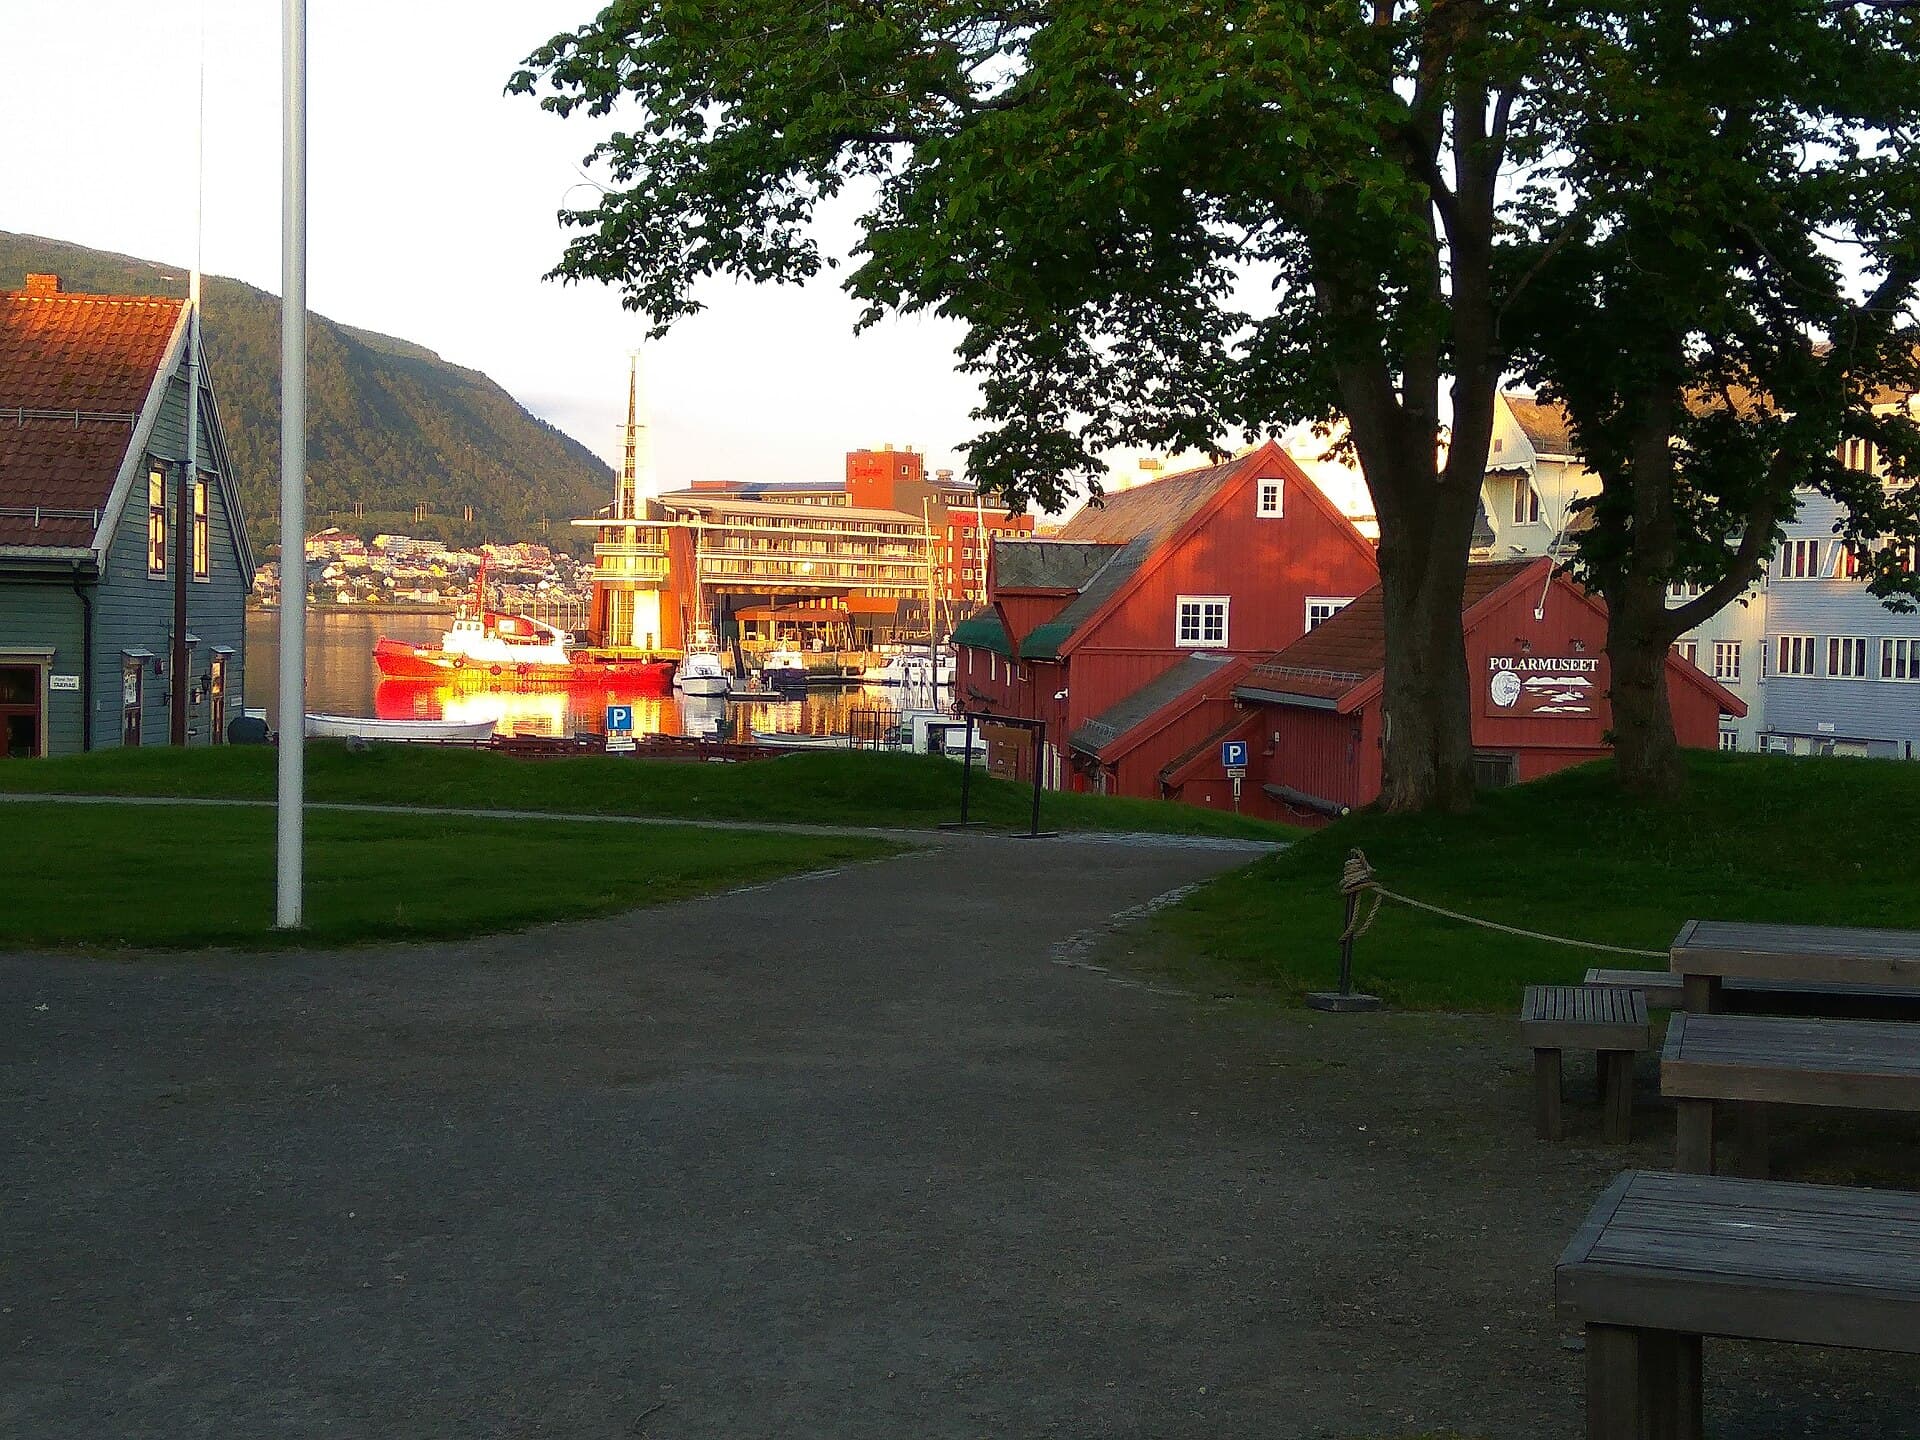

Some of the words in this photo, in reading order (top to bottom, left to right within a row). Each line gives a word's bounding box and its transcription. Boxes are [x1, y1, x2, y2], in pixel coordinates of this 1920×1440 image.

[1489, 657, 1599, 672] POLARMUSEET
[613, 708, 627, 728] P
[1229, 745, 1242, 763] P
